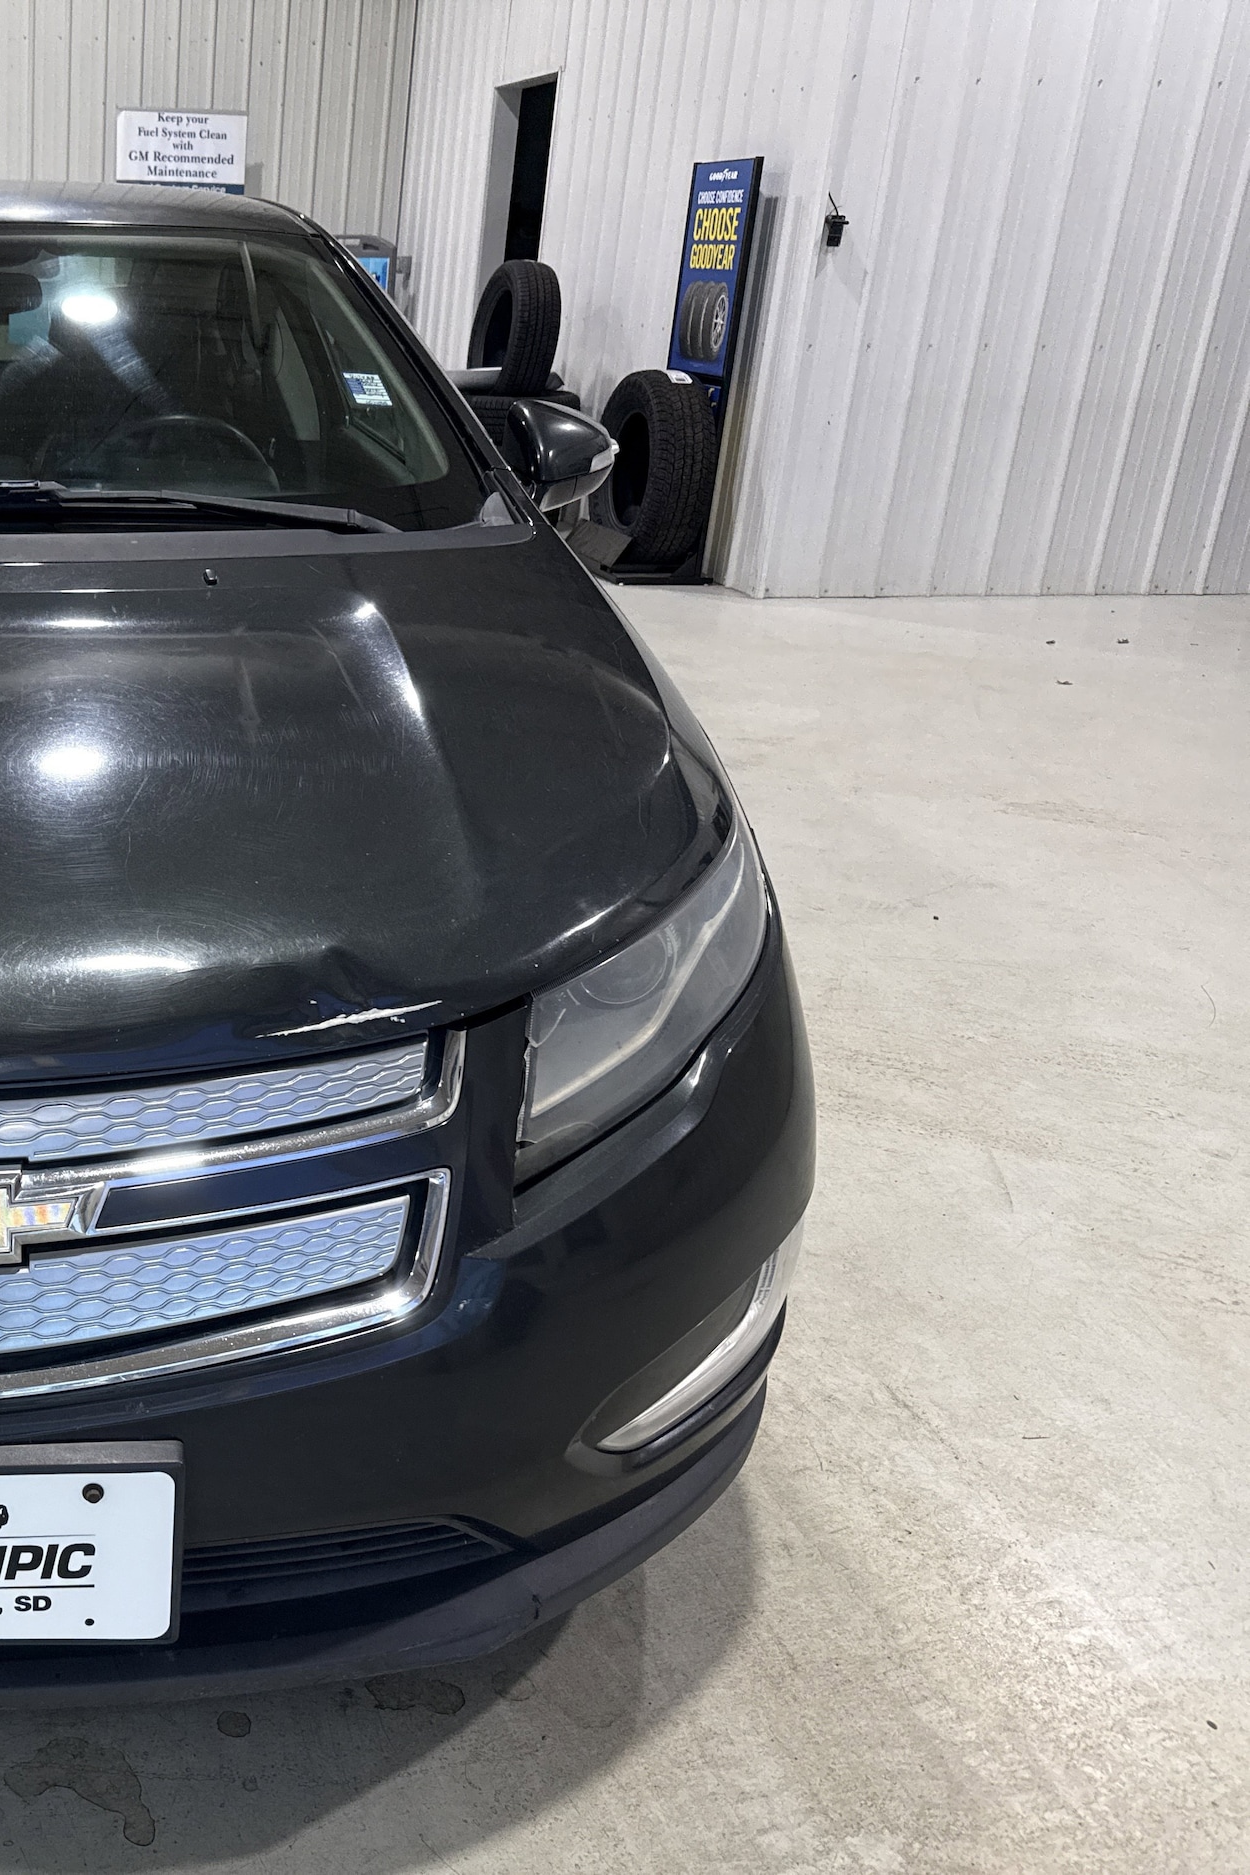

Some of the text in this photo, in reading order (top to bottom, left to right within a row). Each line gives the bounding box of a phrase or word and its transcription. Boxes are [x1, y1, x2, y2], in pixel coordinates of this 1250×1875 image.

[157, 112, 209, 126] Keep your
[137, 127, 227, 141] Fuel System Clean
[172, 141, 194, 151] with
[128, 150, 234, 165] GM Recommended
[147, 165, 218, 179] Maintenance
[709, 168, 738, 182] GOODYEAR
[698, 189, 744, 204] CHOOSE CONFIDENCE
[693, 207, 741, 241] CHOOSE
[689, 244, 736, 270] GOODYEAR
[14, 1595, 52, 1612] SD
